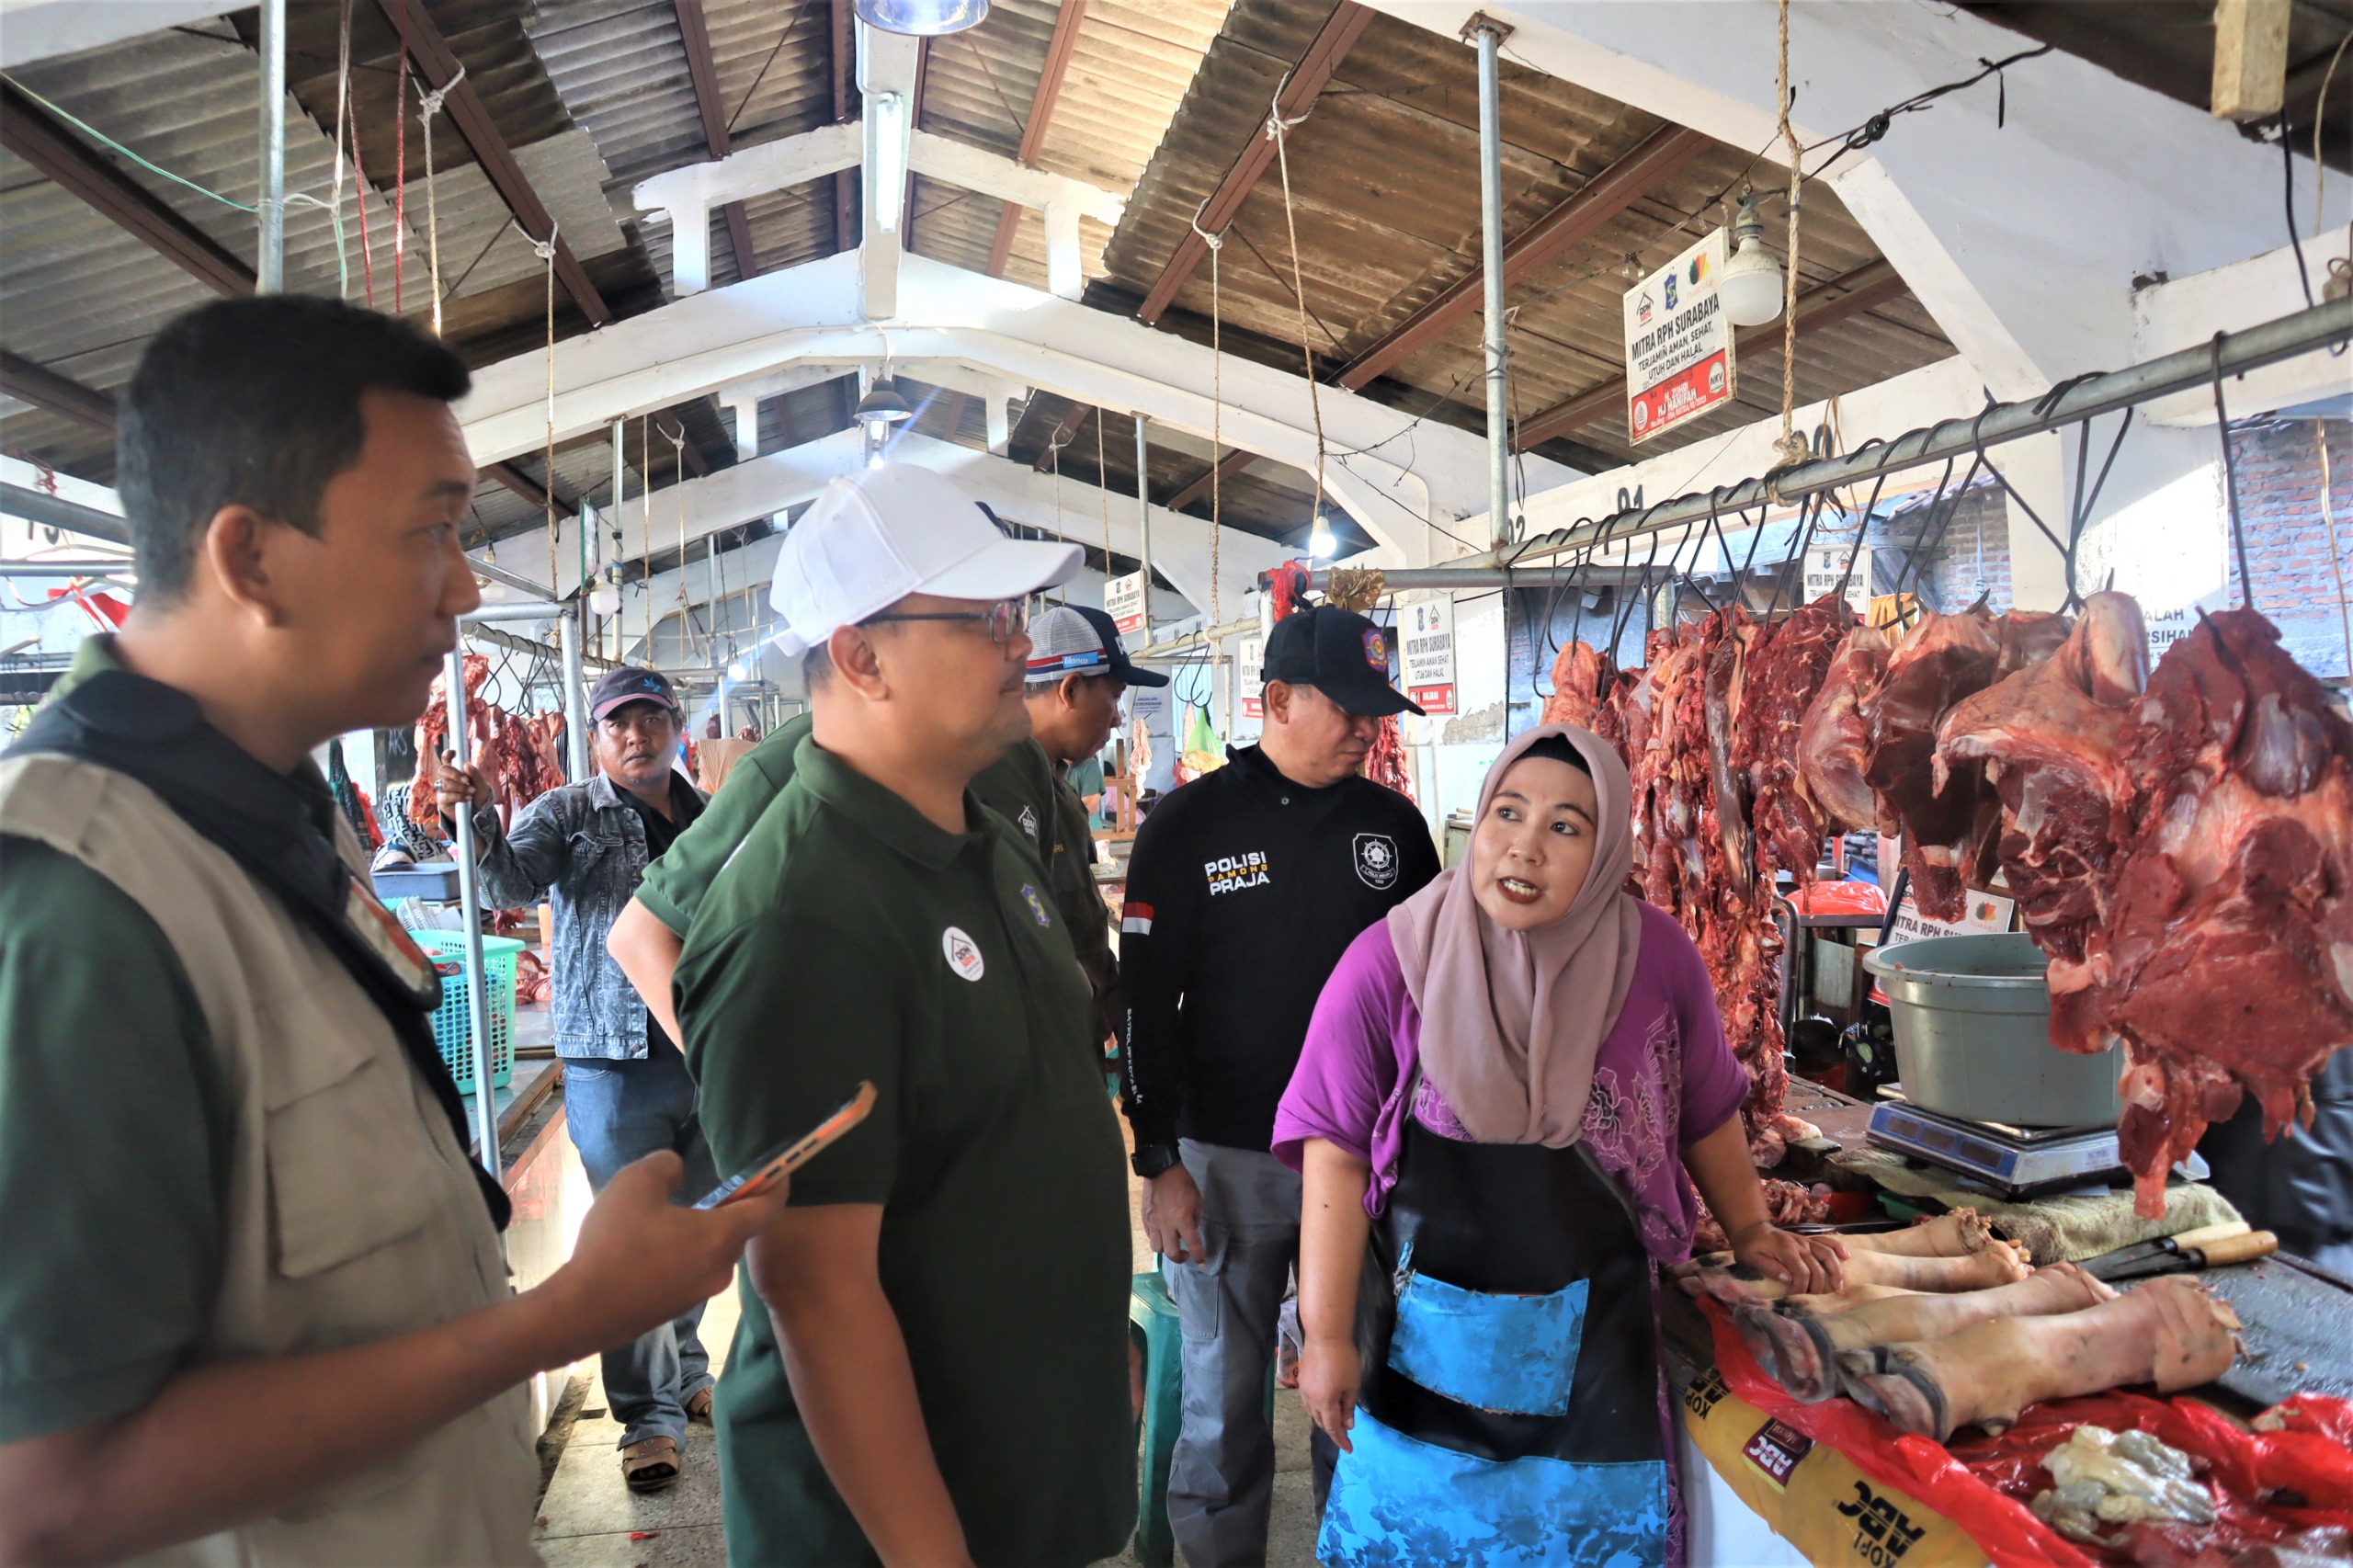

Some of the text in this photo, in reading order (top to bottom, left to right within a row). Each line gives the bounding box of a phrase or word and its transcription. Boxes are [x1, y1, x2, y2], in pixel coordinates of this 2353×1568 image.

[1631, 332, 1655, 361] MITRA
[1657, 320, 1674, 347] RPH
[1675, 293, 1720, 335] SURABAYA
[1638, 347, 1667, 372] TERJAMIN
[1669, 335, 1689, 355] AMAN,
[1691, 321, 1713, 342] SEHAT,
[1648, 362, 1665, 380] UTUH
[1666, 354, 1680, 370] DAN
[1681, 342, 1703, 360] HALAL
[1710, 371, 1723, 385] NKV
[1807, 574, 1823, 586] MITRA
[1824, 574, 1835, 586] RPH
[2144, 608, 2184, 621] ALAH
[1406, 633, 1450, 655] MITRA RPH SURABAYA
[1063, 656, 1088, 665] Elanco
[1204, 850, 1267, 877] POLISI
[1207, 864, 1268, 883] PAMONG
[1210, 871, 1271, 896] PRAJA
[1895, 915, 1918, 933] ITRA
[1920, 922, 1941, 937] RPH
[1749, 1436, 1793, 1476] ABC
[1837, 1480, 1927, 1559] ABC
